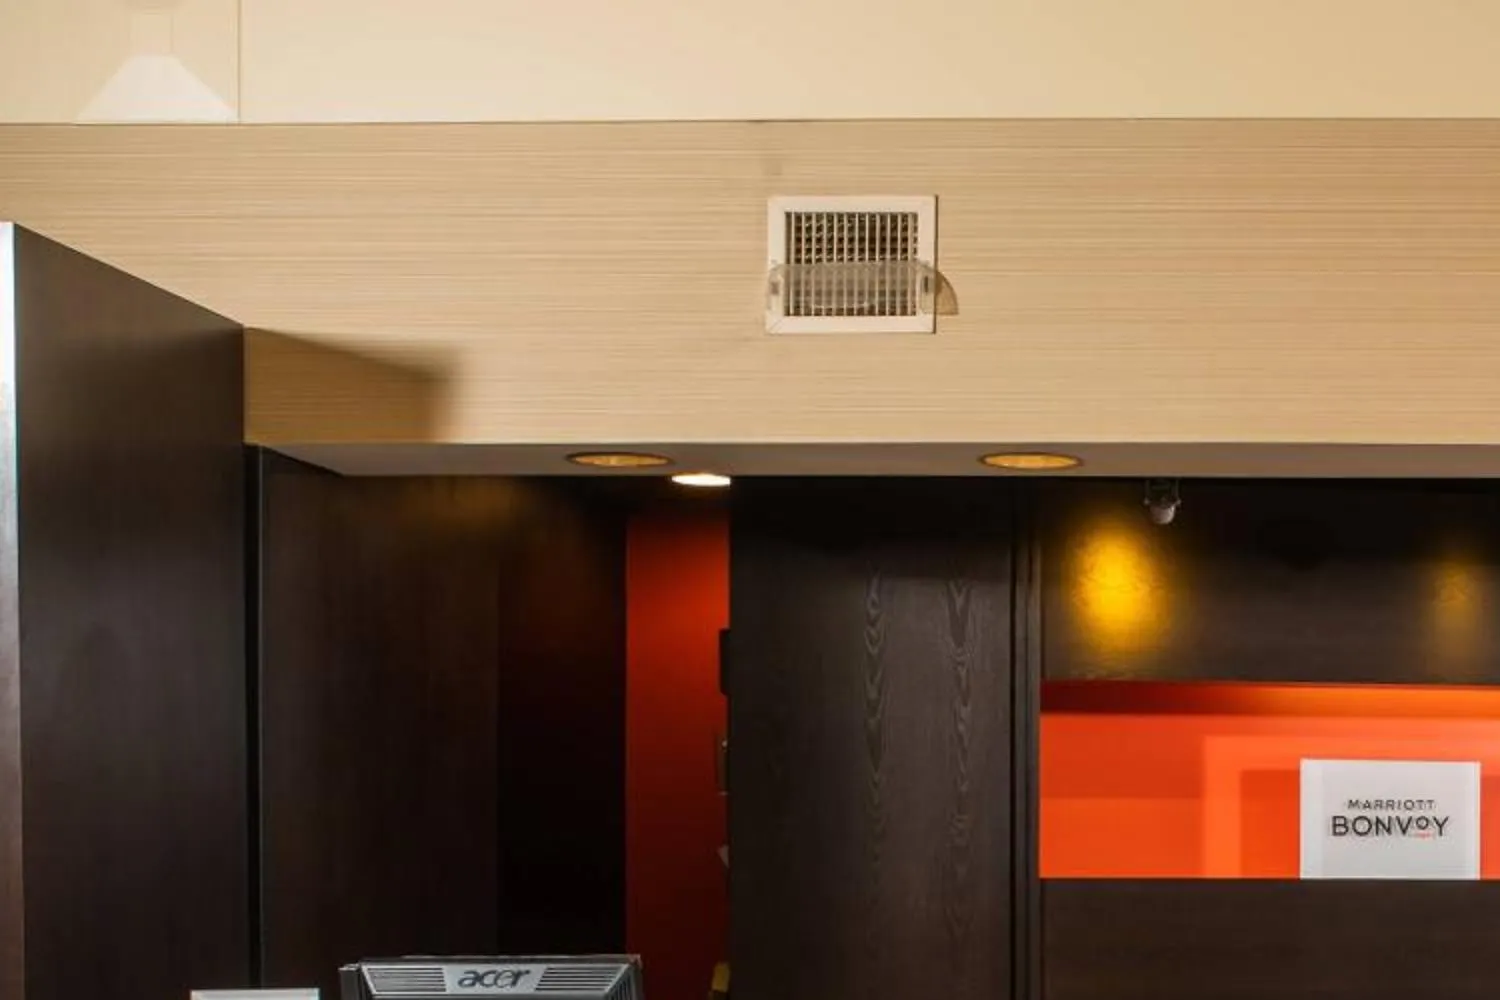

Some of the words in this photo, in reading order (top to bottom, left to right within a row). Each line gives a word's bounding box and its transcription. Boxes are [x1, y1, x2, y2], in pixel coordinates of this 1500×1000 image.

[1347, 799, 1435, 811] MARRIOTT
[1331, 815, 1450, 837] BONVOY
[458, 968, 531, 988] acer
